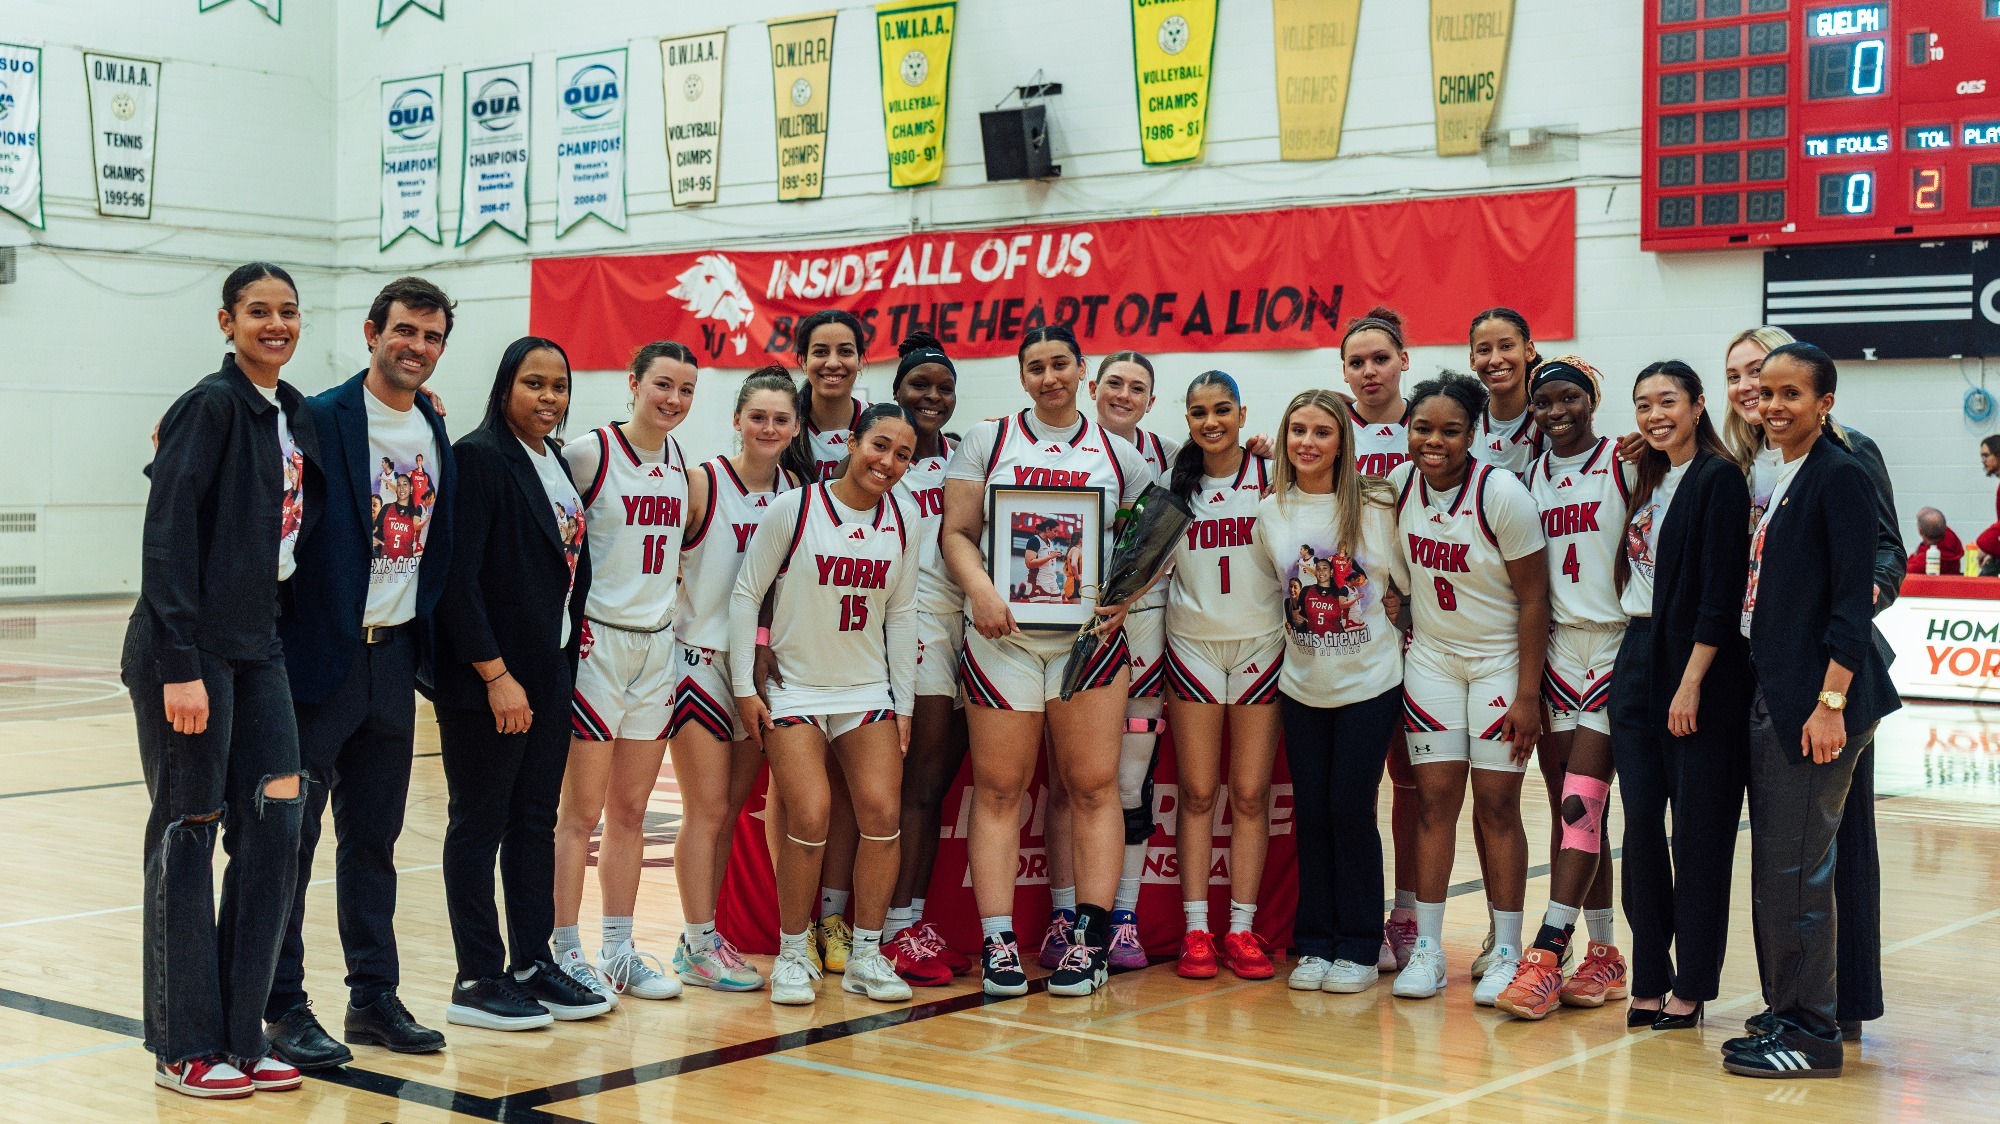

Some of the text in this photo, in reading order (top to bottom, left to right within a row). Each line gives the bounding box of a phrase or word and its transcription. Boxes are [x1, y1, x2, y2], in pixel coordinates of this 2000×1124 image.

[1435, 11, 1506, 42] VOLLEYBALL
[1816, 8, 1879, 37] GUELPH
[1283, 22, 1347, 51] VOLLEYBALL
[1143, 65, 1204, 84] VOLLEYBALL
[1851, 40, 1885, 94] 0
[563, 82, 619, 106] OUA
[1286, 75, 1338, 104] CHAMPS
[1439, 71, 1495, 104] CHAMPS
[1956, 79, 1987, 95] OES
[471, 95, 521, 117] OUA
[1149, 92, 1199, 112] CHAMPS
[388, 105, 435, 127] OUA
[778, 112, 826, 139] VOLLEYBALL
[0, 130, 36, 147] IONS
[103, 132, 143, 150] TENNIS
[668, 121, 718, 141] VOLLEYBALL
[892, 120, 936, 139] CHAMPS
[1918, 131, 1950, 148] TOL
[782, 144, 820, 167] CHAMPS
[1836, 135, 1888, 154] FOULS
[470, 149, 526, 167] CHAMPIONS
[676, 149, 712, 167] CHAMPS
[103, 164, 146, 183] CHAMPS
[104, 190, 146, 208] 1995-96
[1846, 173, 1871, 213] 0
[1916, 169, 1939, 209] 2
[766, 230, 1094, 300] INSIDE ALL OF US
[887, 301, 964, 344] THE
[967, 295, 1109, 344] HEART
[1114, 291, 1178, 337] OF
[1181, 290, 1214, 336] A
[1224, 284, 1344, 335] LION
[701, 322, 727, 361] YU
[1013, 465, 1092, 488] YORK
[621, 495, 682, 528] YORK
[390, 521, 410, 533] YORK
[1186, 516, 1257, 551] YORK
[393, 534, 401, 549] 5
[1408, 533, 1471, 573] YORK
[642, 534, 667, 575] 16
[1562, 543, 1581, 583] 4
[815, 553, 892, 590] YORK
[1218, 555, 1231, 595] 1
[1311, 600, 1334, 611] YORK
[1433, 576, 1457, 612] 8
[838, 594, 869, 632] 15
[1317, 612, 1325, 625] 5
[1324, 624, 1372, 648] Grewal
[1926, 618, 2000, 643] HOM
[684, 647, 700, 667] YU
